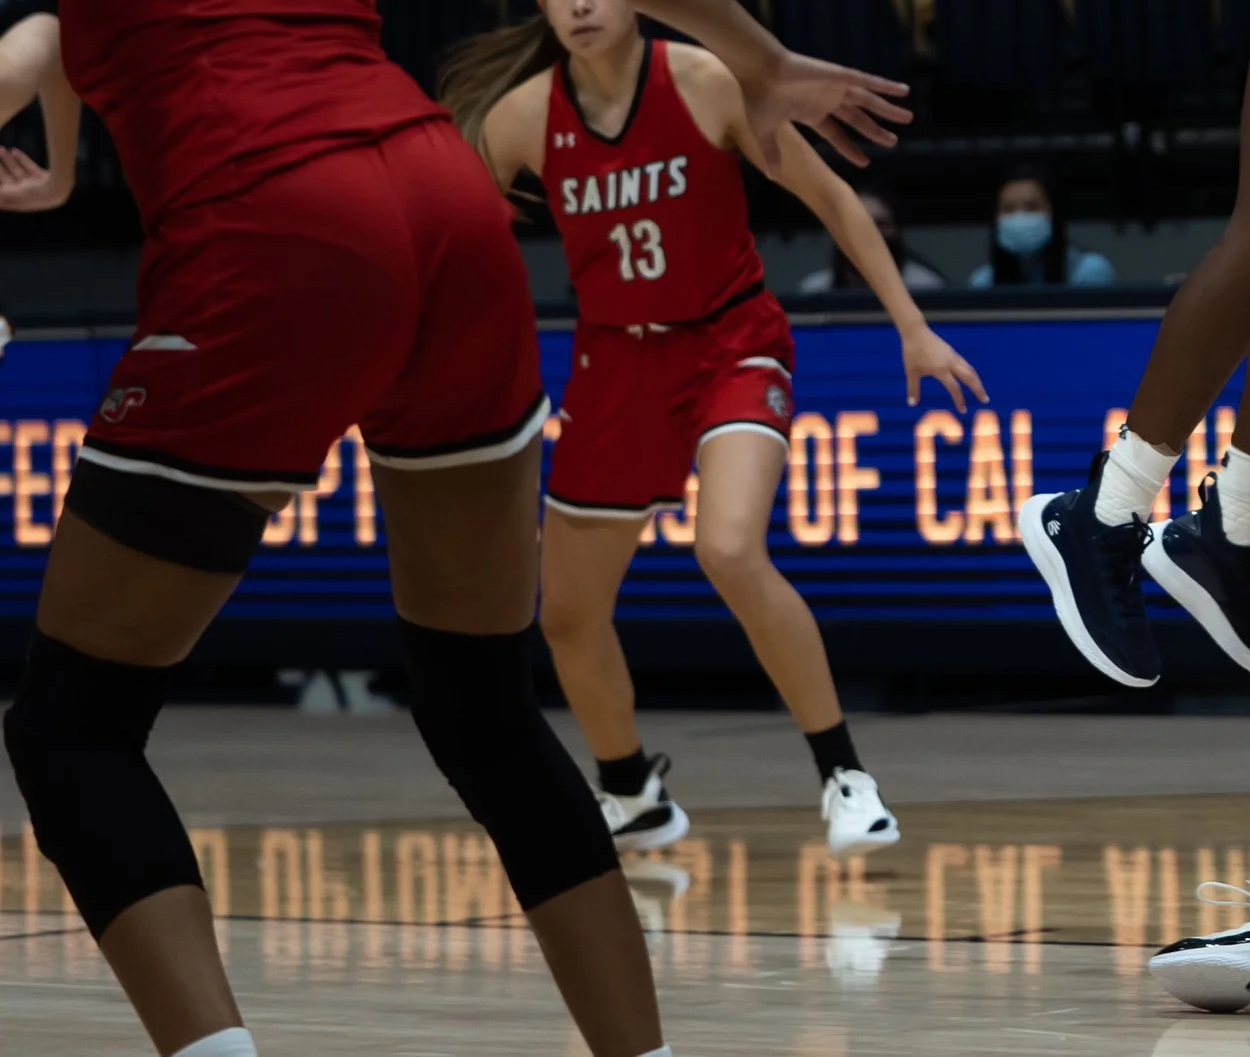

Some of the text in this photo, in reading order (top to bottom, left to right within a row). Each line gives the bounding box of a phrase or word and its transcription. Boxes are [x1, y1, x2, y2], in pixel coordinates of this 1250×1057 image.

[561, 154, 688, 216] SAINTS
[607, 218, 667, 281] 13
[787, 410, 881, 546] OF
